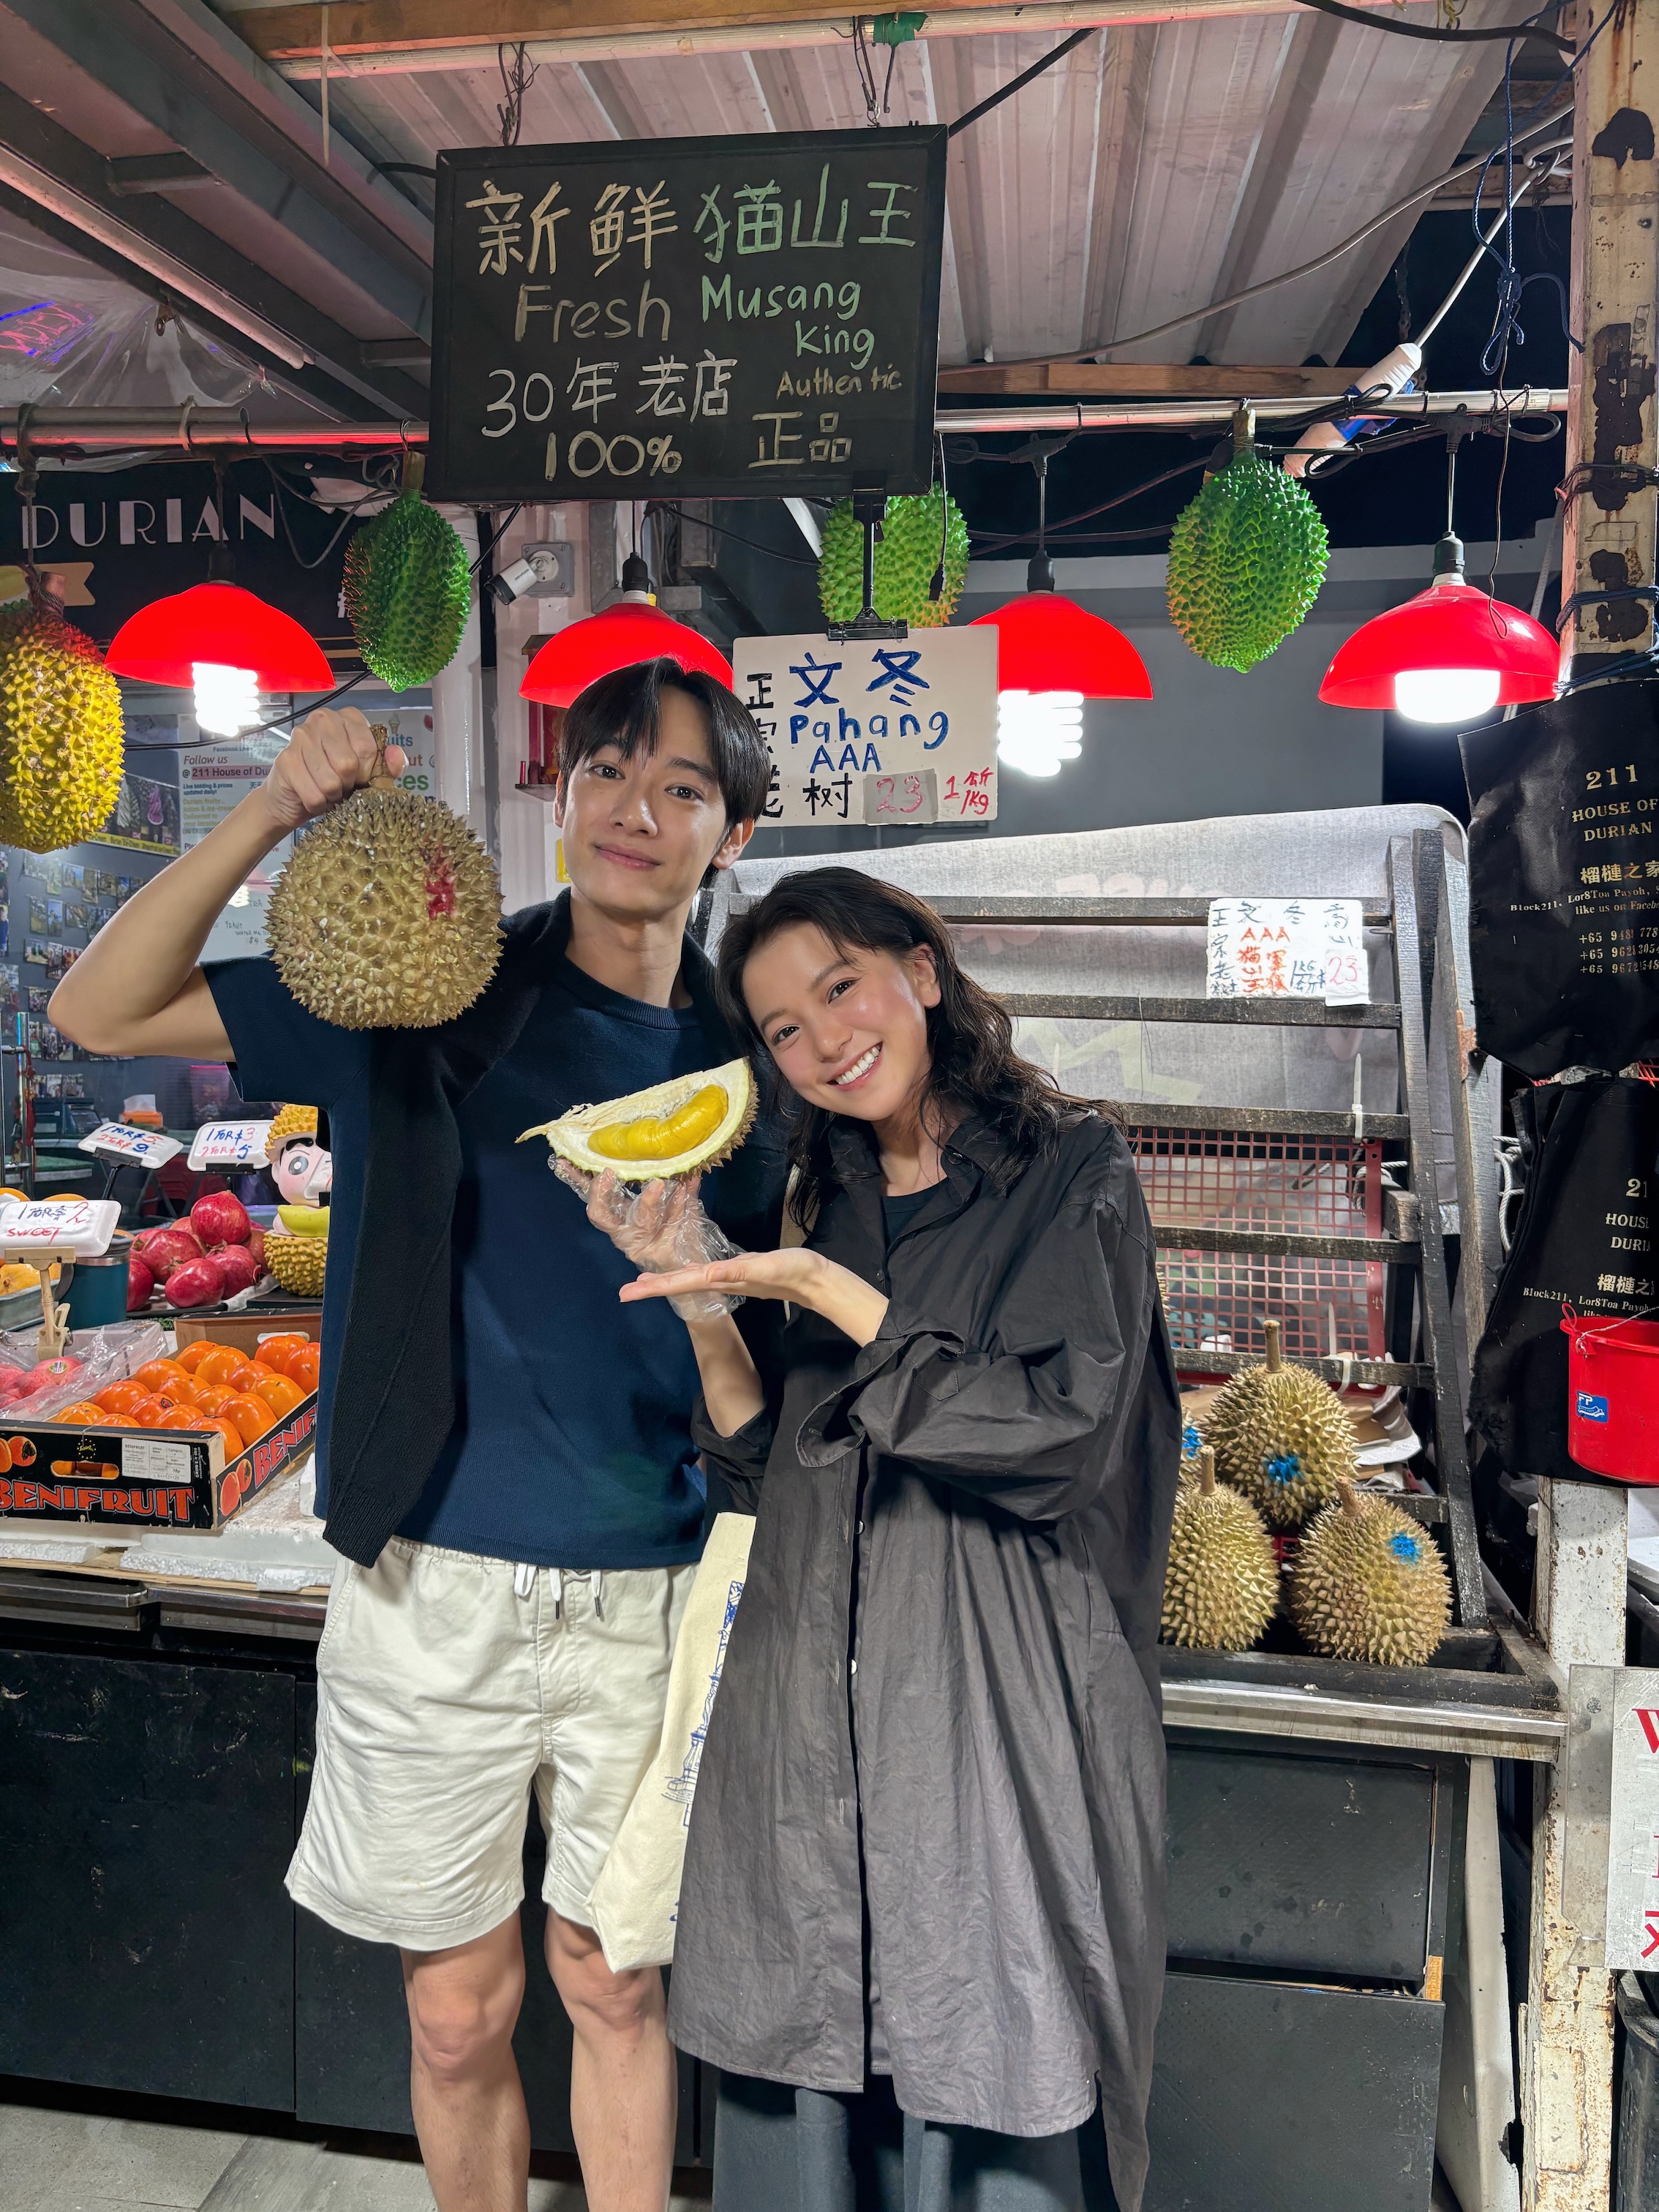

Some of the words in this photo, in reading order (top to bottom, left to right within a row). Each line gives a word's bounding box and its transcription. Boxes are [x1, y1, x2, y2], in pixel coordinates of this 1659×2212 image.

[464, 178, 680, 277] 新鲜
[692, 162, 919, 264] 猫山王
[514, 279, 672, 343] Fresh
[701, 273, 862, 323] Musang
[794, 320, 876, 371] King
[747, 410, 853, 470] 正品
[544, 429, 683, 483] 100%
[21, 493, 276, 550] DURIAN
[789, 648, 930, 708] 文冬
[789, 707, 950, 750] Pahang
[182, 769, 190, 778] @
[192, 768, 210, 778] 211
[212, 767, 241, 777] House
[244, 767, 253, 776] of
[184, 755, 215, 765] Follow
[217, 756, 228, 764] us
[809, 742, 883, 774] AAA
[1585, 764, 1639, 791] 211
[802, 772, 854, 819] 树
[876, 774, 925, 814] 23
[1571, 802, 1632, 823] HOUSE
[1636, 798, 1659, 812] OF
[1583, 821, 1652, 842] DURIAN
[1575, 905, 1595, 915] like
[1598, 904, 1610, 913] us
[1614, 903, 1627, 911] on
[1240, 926, 1290, 943] AAA
[1579, 931, 1603, 944] +65
[1579, 948, 1603, 960] +65
[1579, 964, 1603, 974] +65
[206, 1128, 215, 1141] 1
[214, 1129, 233, 1140] FOR
[200, 1146, 209, 1156] 2
[211, 1146, 227, 1155] FOR
[18, 1203, 28, 1219] 1
[252, 1402, 318, 1490] BENIF
[0, 1476, 195, 1522] BENIFRUIT
